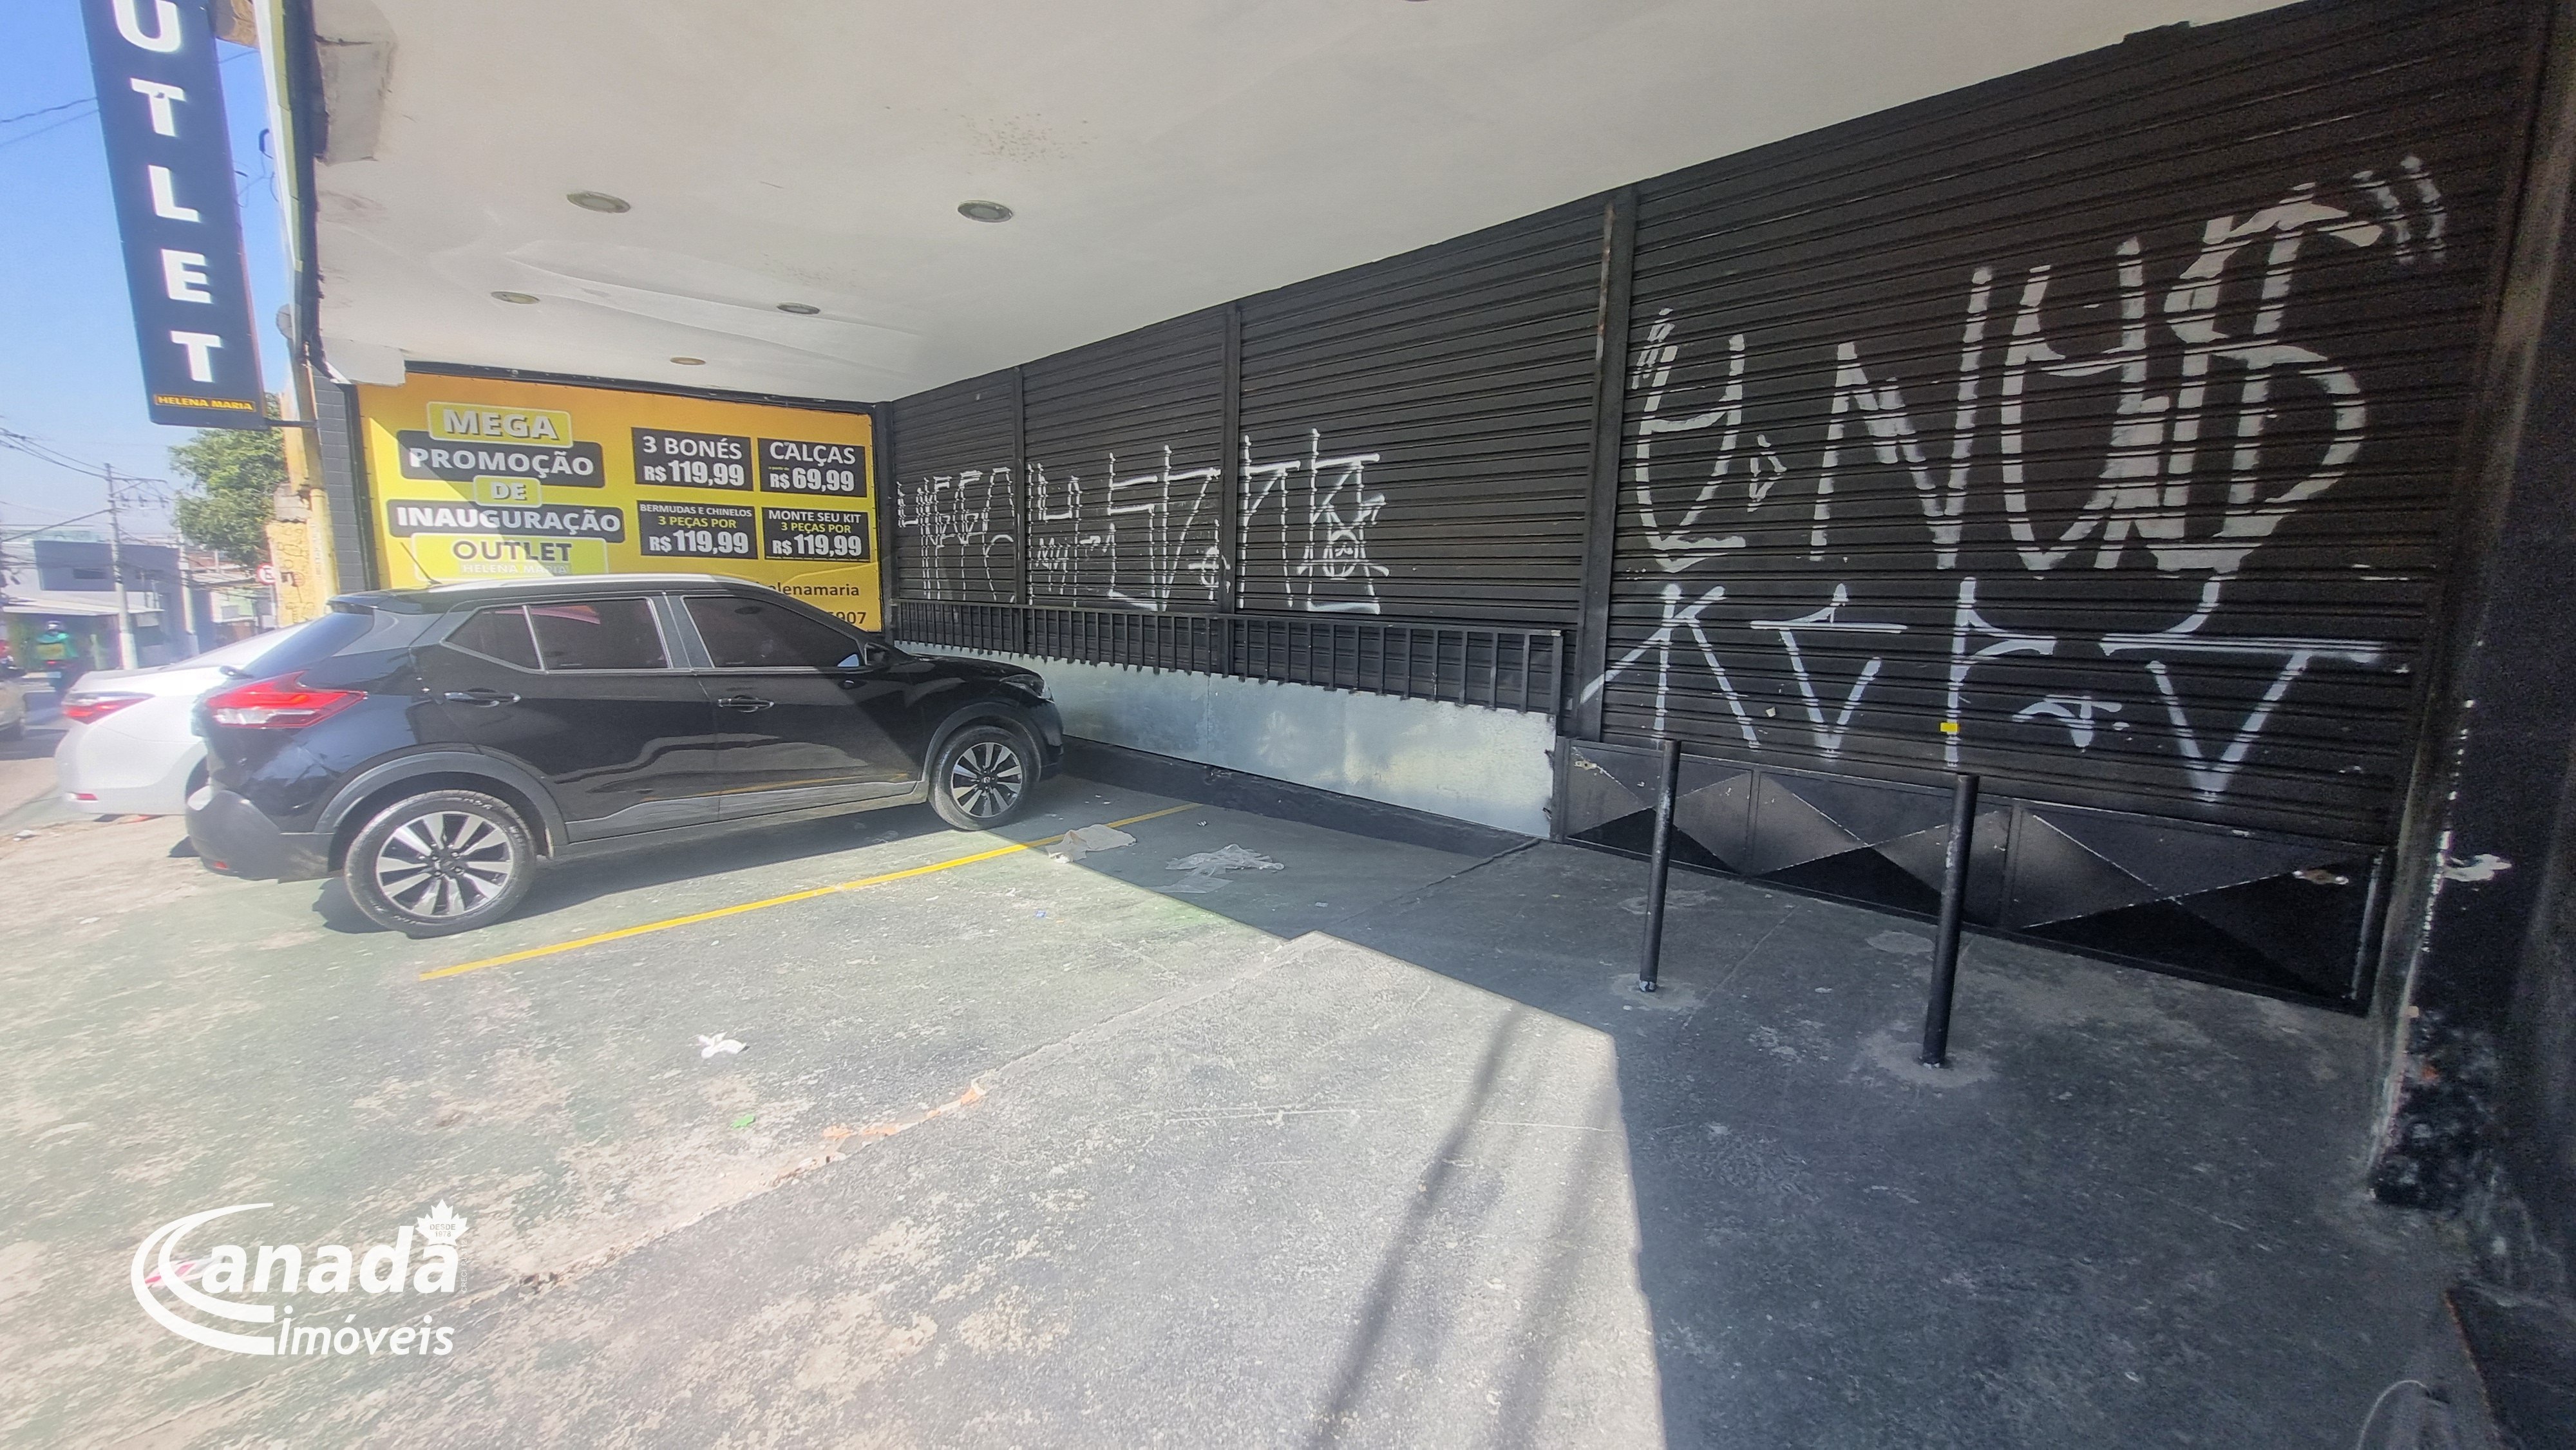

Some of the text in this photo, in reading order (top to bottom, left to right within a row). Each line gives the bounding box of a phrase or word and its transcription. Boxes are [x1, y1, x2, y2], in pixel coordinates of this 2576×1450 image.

[158, 396, 253, 410] HELENA MARIA
[443, 408, 560, 440] MEGA
[643, 436, 742, 459] 3 BONÉS
[770, 442, 856, 466] CALÇAS
[410, 447, 594, 478] PROMOÇÃO
[644, 460, 744, 486] R$ 119,99
[770, 467, 855, 492] R$ 69,99
[491, 482, 527, 500] DE
[396, 507, 621, 535] INAUGURAÇÃO
[639, 504, 696, 514] BERMUDAS
[706, 507, 752, 517] CHINELOS
[768, 510, 862, 523] MONTE SEU KIT
[658, 516, 737, 529] 3 PEÇAS POR
[781, 522, 851, 534] 3 PEÇAS POR
[453, 540, 573, 562] OUTLET
[649, 530, 749, 555] R$ 119,99
[772, 534, 862, 557] R$ 119,99
[463, 564, 568, 575] HELENA MARIA
[828, 611, 867, 625] 907
